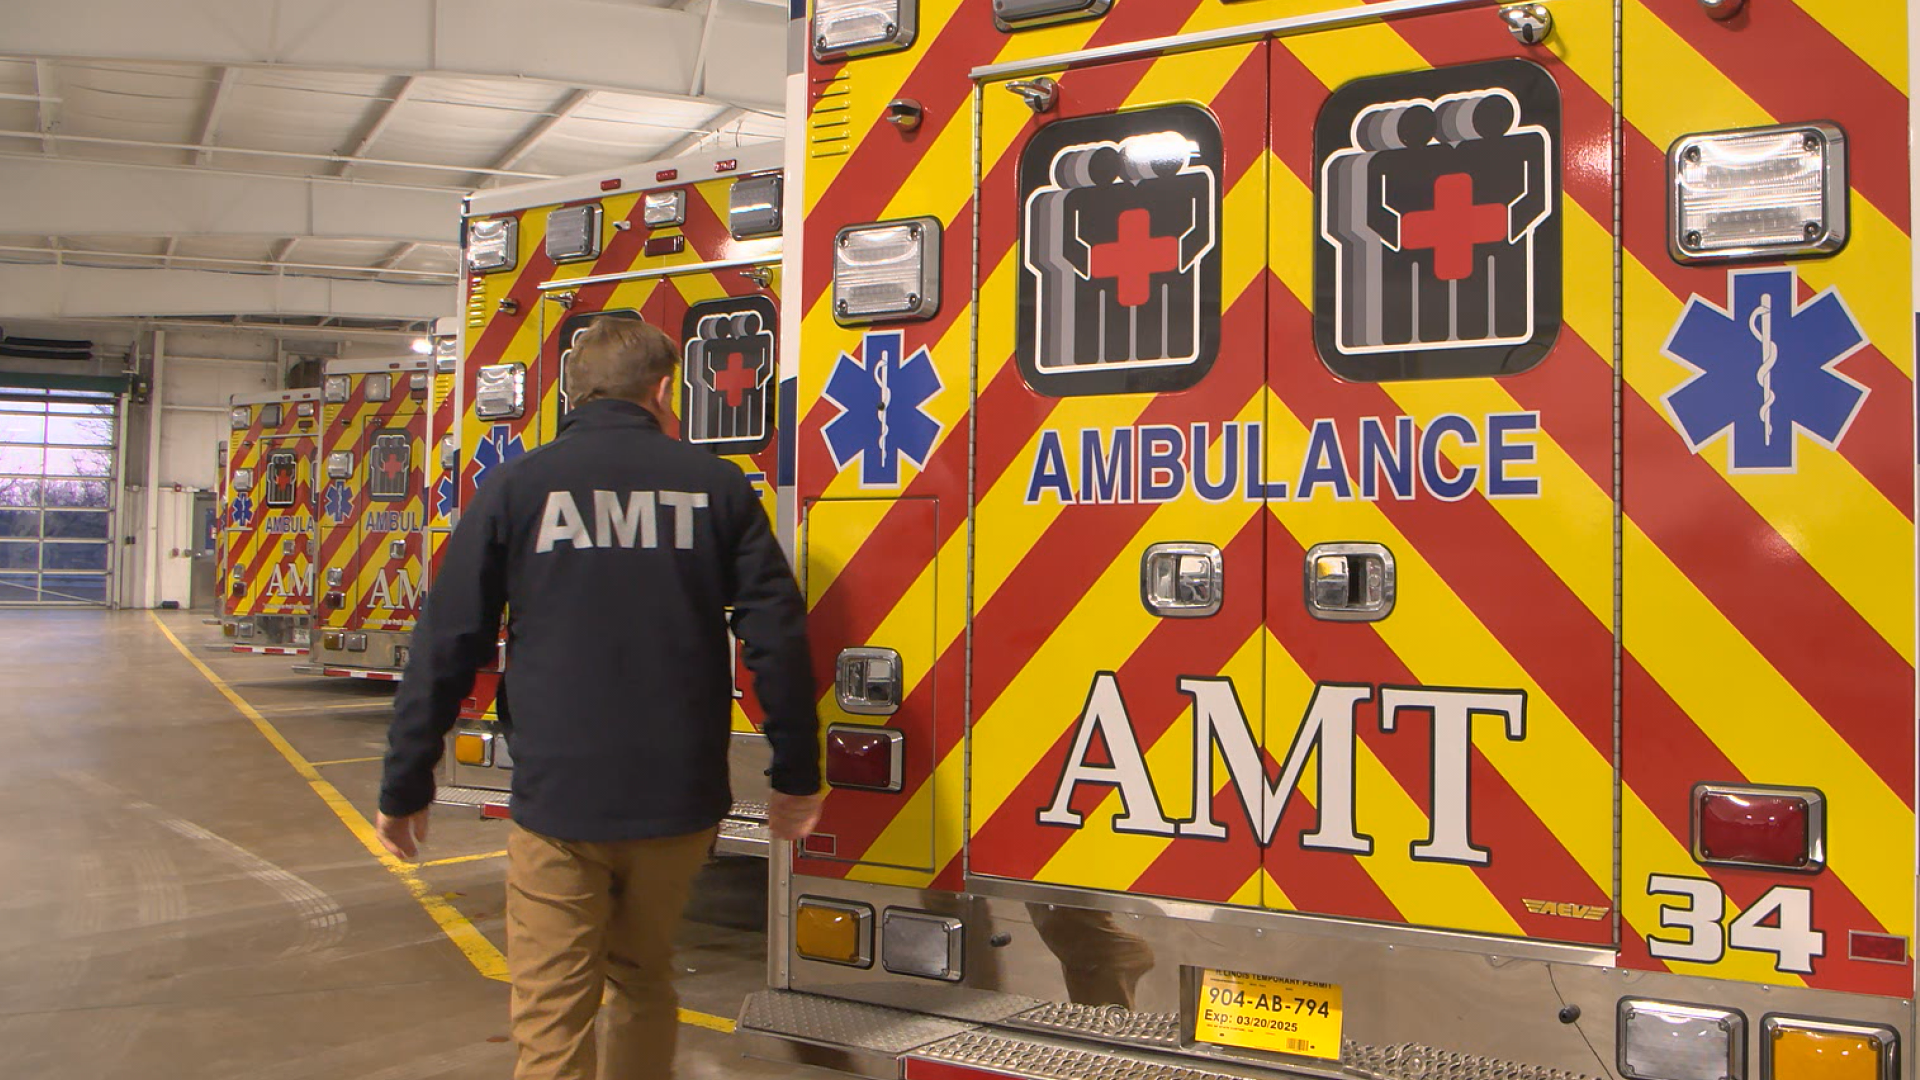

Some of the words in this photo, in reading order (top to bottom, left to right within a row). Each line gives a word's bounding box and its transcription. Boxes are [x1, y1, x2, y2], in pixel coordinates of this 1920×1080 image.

[1024, 410, 1541, 505] AMBULANCE
[265, 515, 314, 534] AMBULA
[365, 510, 424, 533] AMBUL
[536, 490, 709, 553] AMT
[266, 562, 314, 597] AM
[366, 567, 423, 611] AM
[1036, 670, 1528, 867] AMT
[1646, 873, 1825, 974] 34
[1204, 1008, 1233, 1025] Exp:
[1236, 1015, 1298, 1032] 03/20/2025
[1209, 987, 1330, 1019] 904-AB-794
